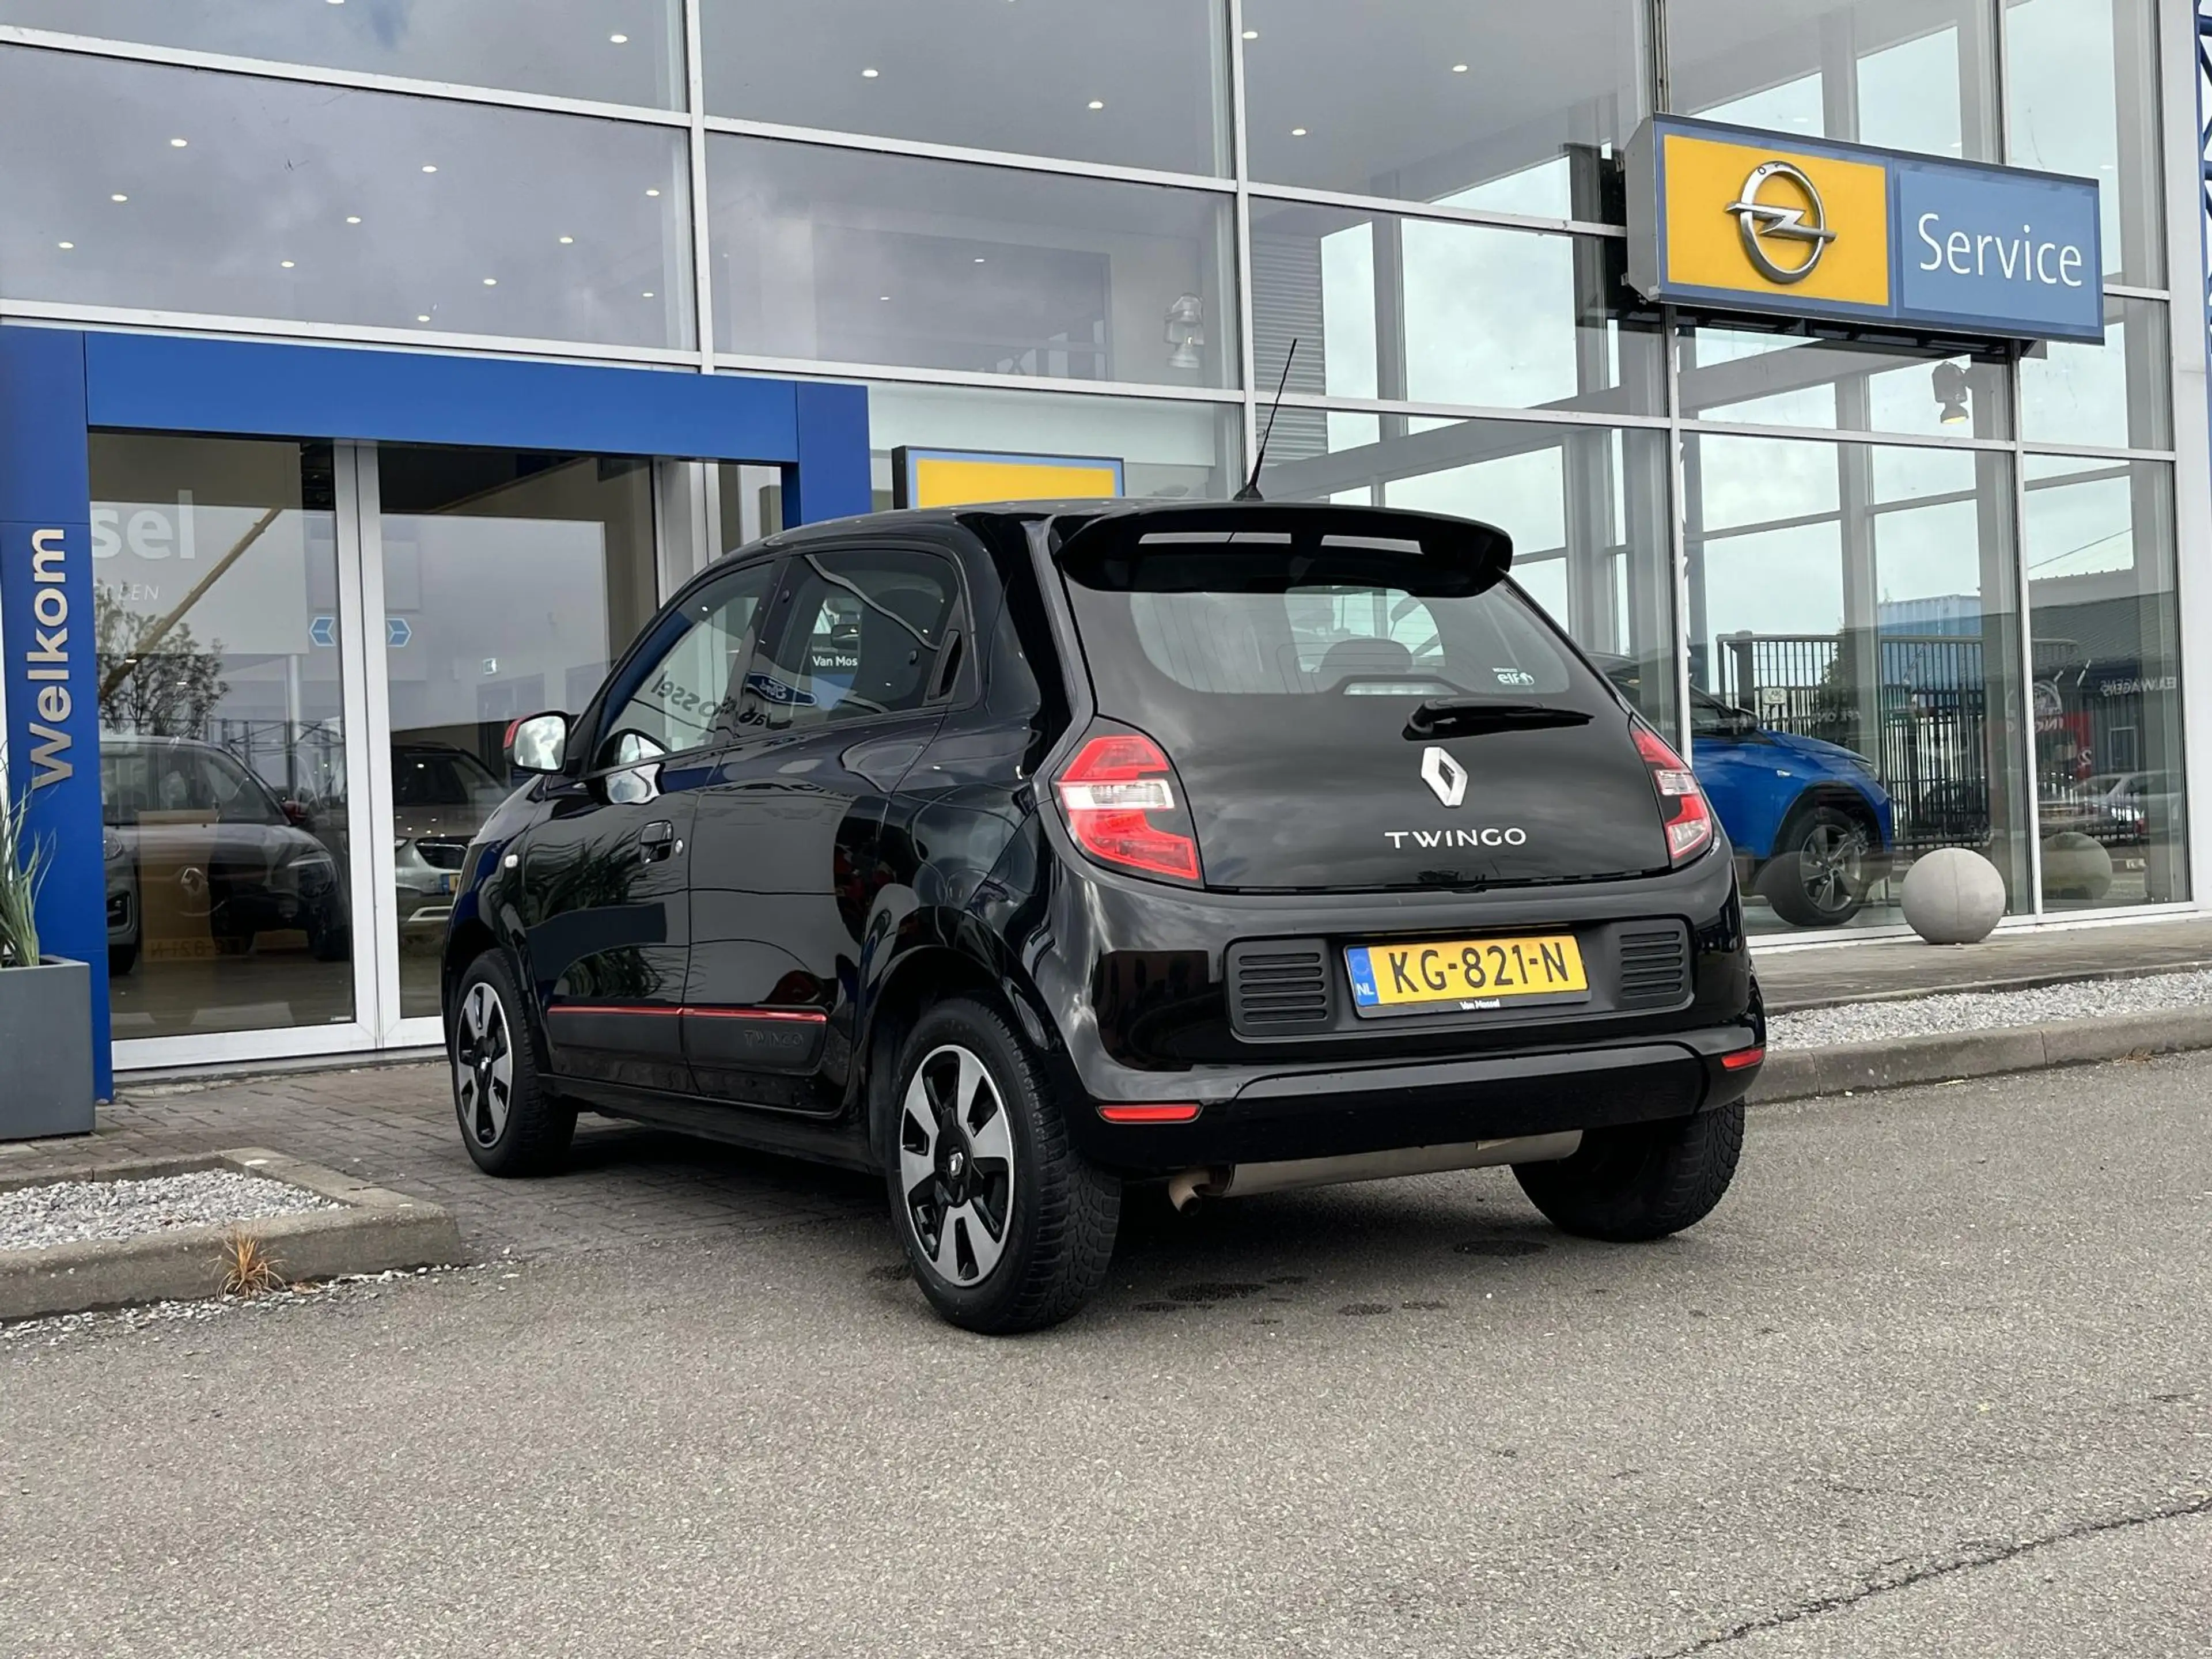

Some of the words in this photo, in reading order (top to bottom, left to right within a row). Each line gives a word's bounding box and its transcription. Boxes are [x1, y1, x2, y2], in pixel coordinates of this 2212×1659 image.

[1918, 213, 2082, 287] Service
[26, 528, 73, 789] Welkom
[811, 655, 833, 666] Van
[1384, 827, 1527, 850] TWINGO
[1387, 940, 1570, 994] KG-821-N
[1356, 982, 1375, 997] NL
[744, 1028, 805, 1047] TWINGO
